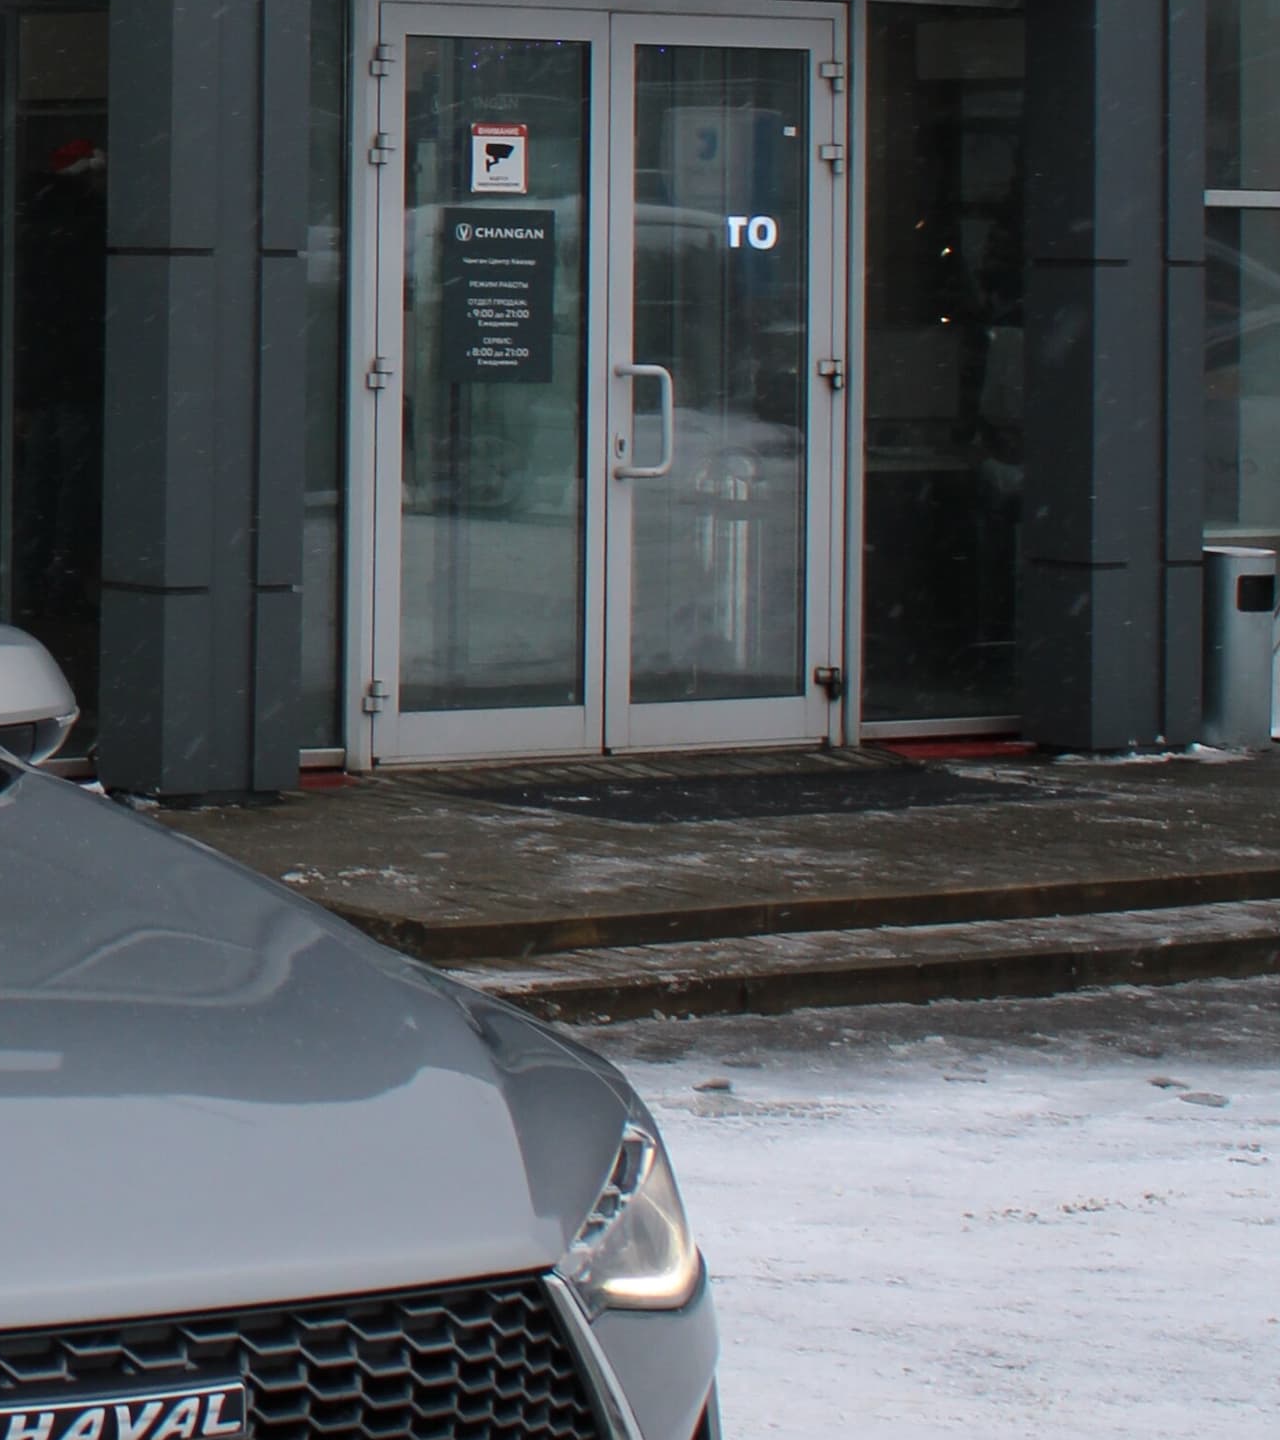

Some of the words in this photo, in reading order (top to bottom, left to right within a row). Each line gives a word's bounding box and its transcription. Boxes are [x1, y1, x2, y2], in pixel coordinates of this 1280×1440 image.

[475, 227, 544, 239] CHANGAN
[472, 308, 494, 318] 9:00
[505, 309, 530, 319] 21:00
[505, 347, 530, 357] 21:00
